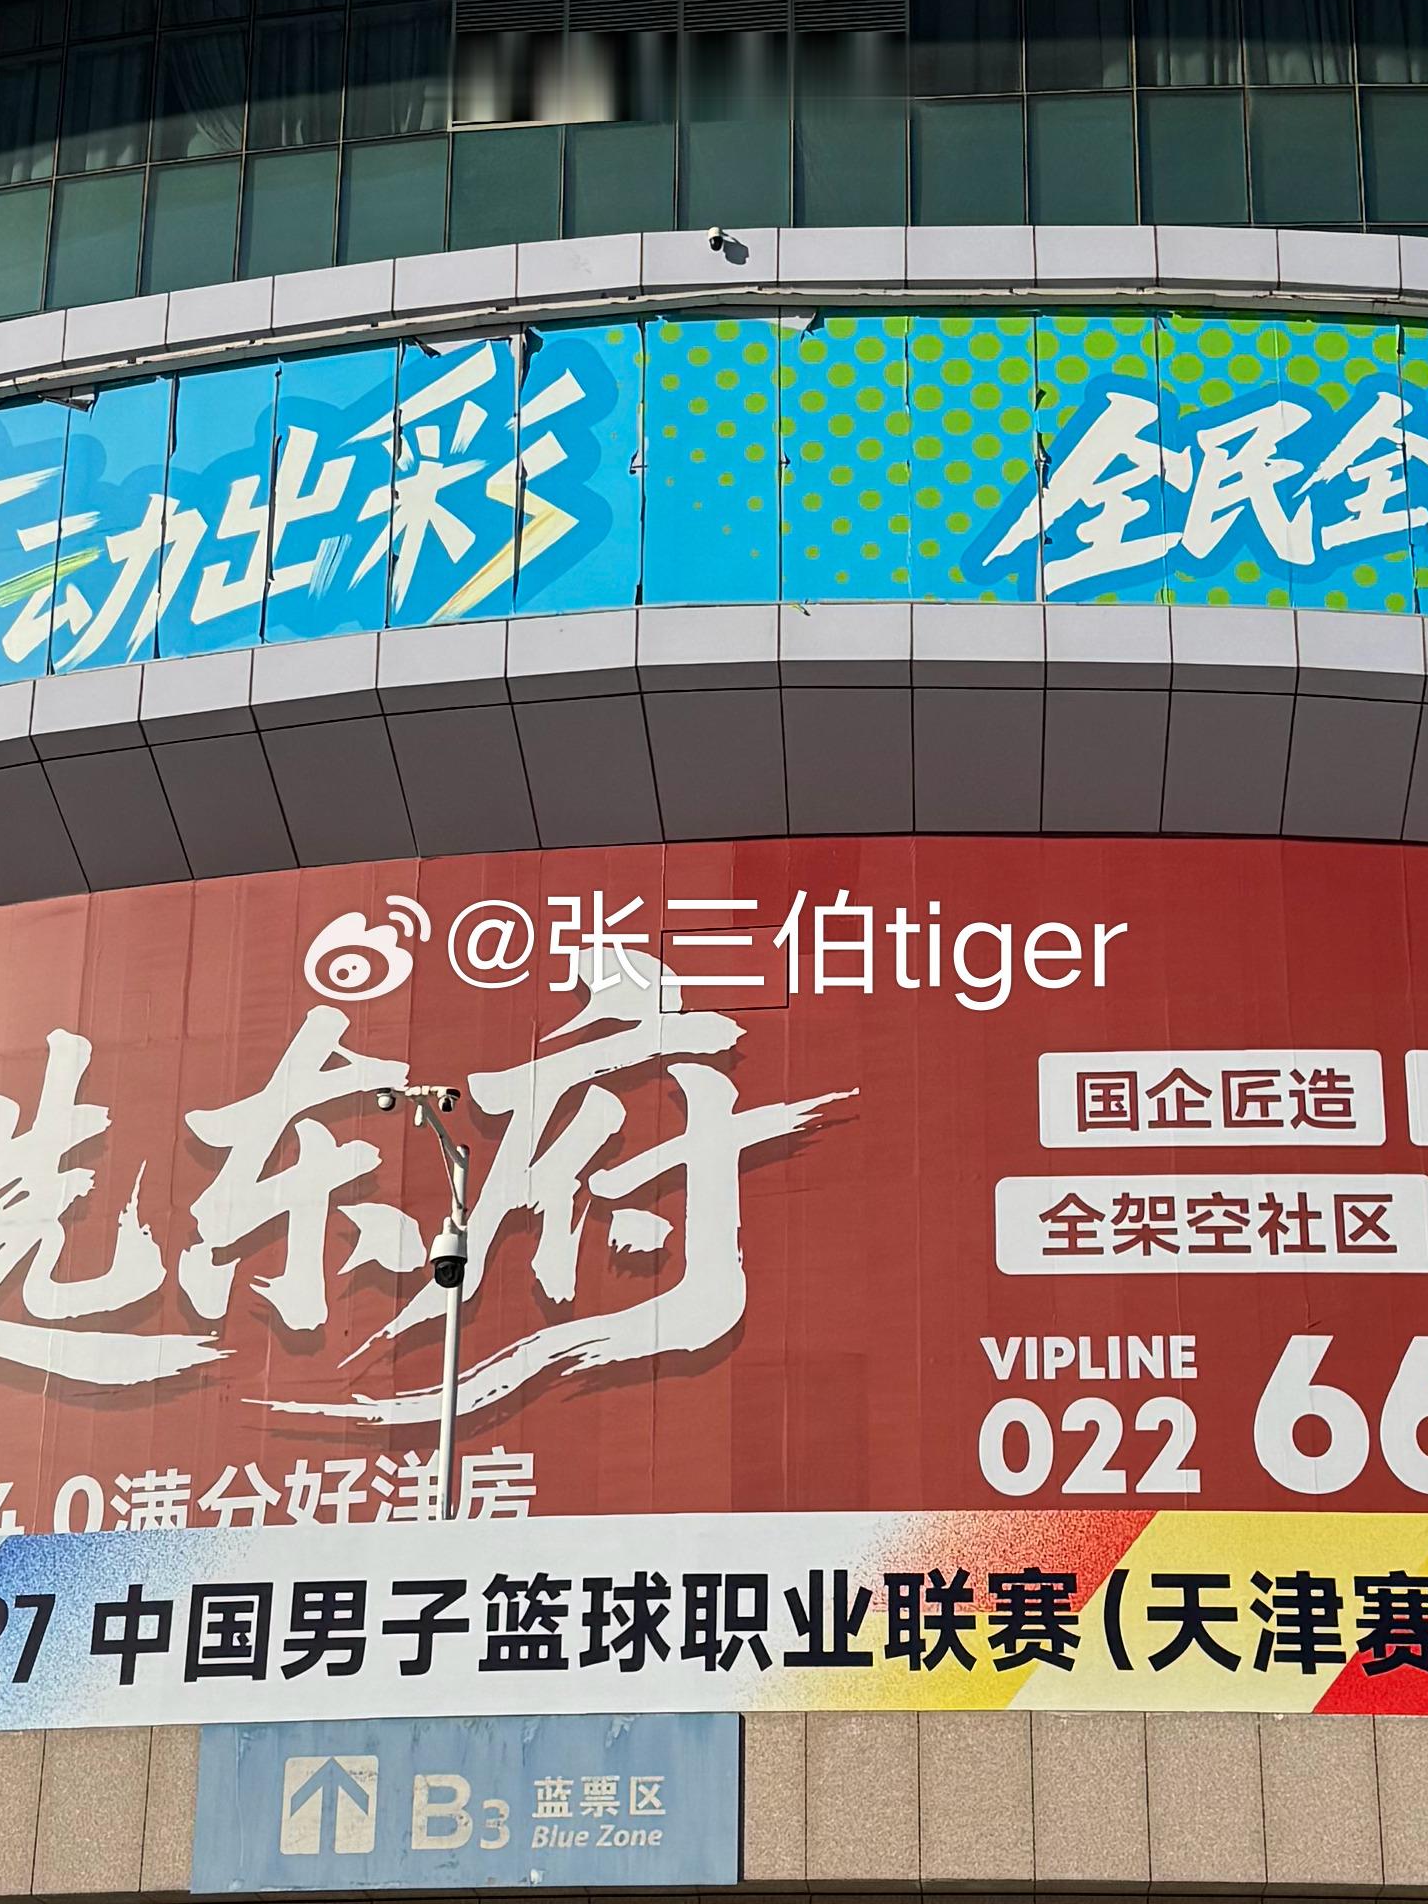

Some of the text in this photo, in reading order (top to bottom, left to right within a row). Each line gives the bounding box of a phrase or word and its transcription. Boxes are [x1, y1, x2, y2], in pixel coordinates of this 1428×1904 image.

[1074, 1066, 1359, 1135] 国企匠造
[1036, 1190, 1401, 1261] 全架空社区
[978, 1334, 1200, 1381] VIPLINE
[975, 1395, 1203, 1497] 022
[411, 1773, 511, 1851] B3
[531, 1775, 667, 1819] 蓝票区
[531, 1824, 664, 1849] Blue Zone
